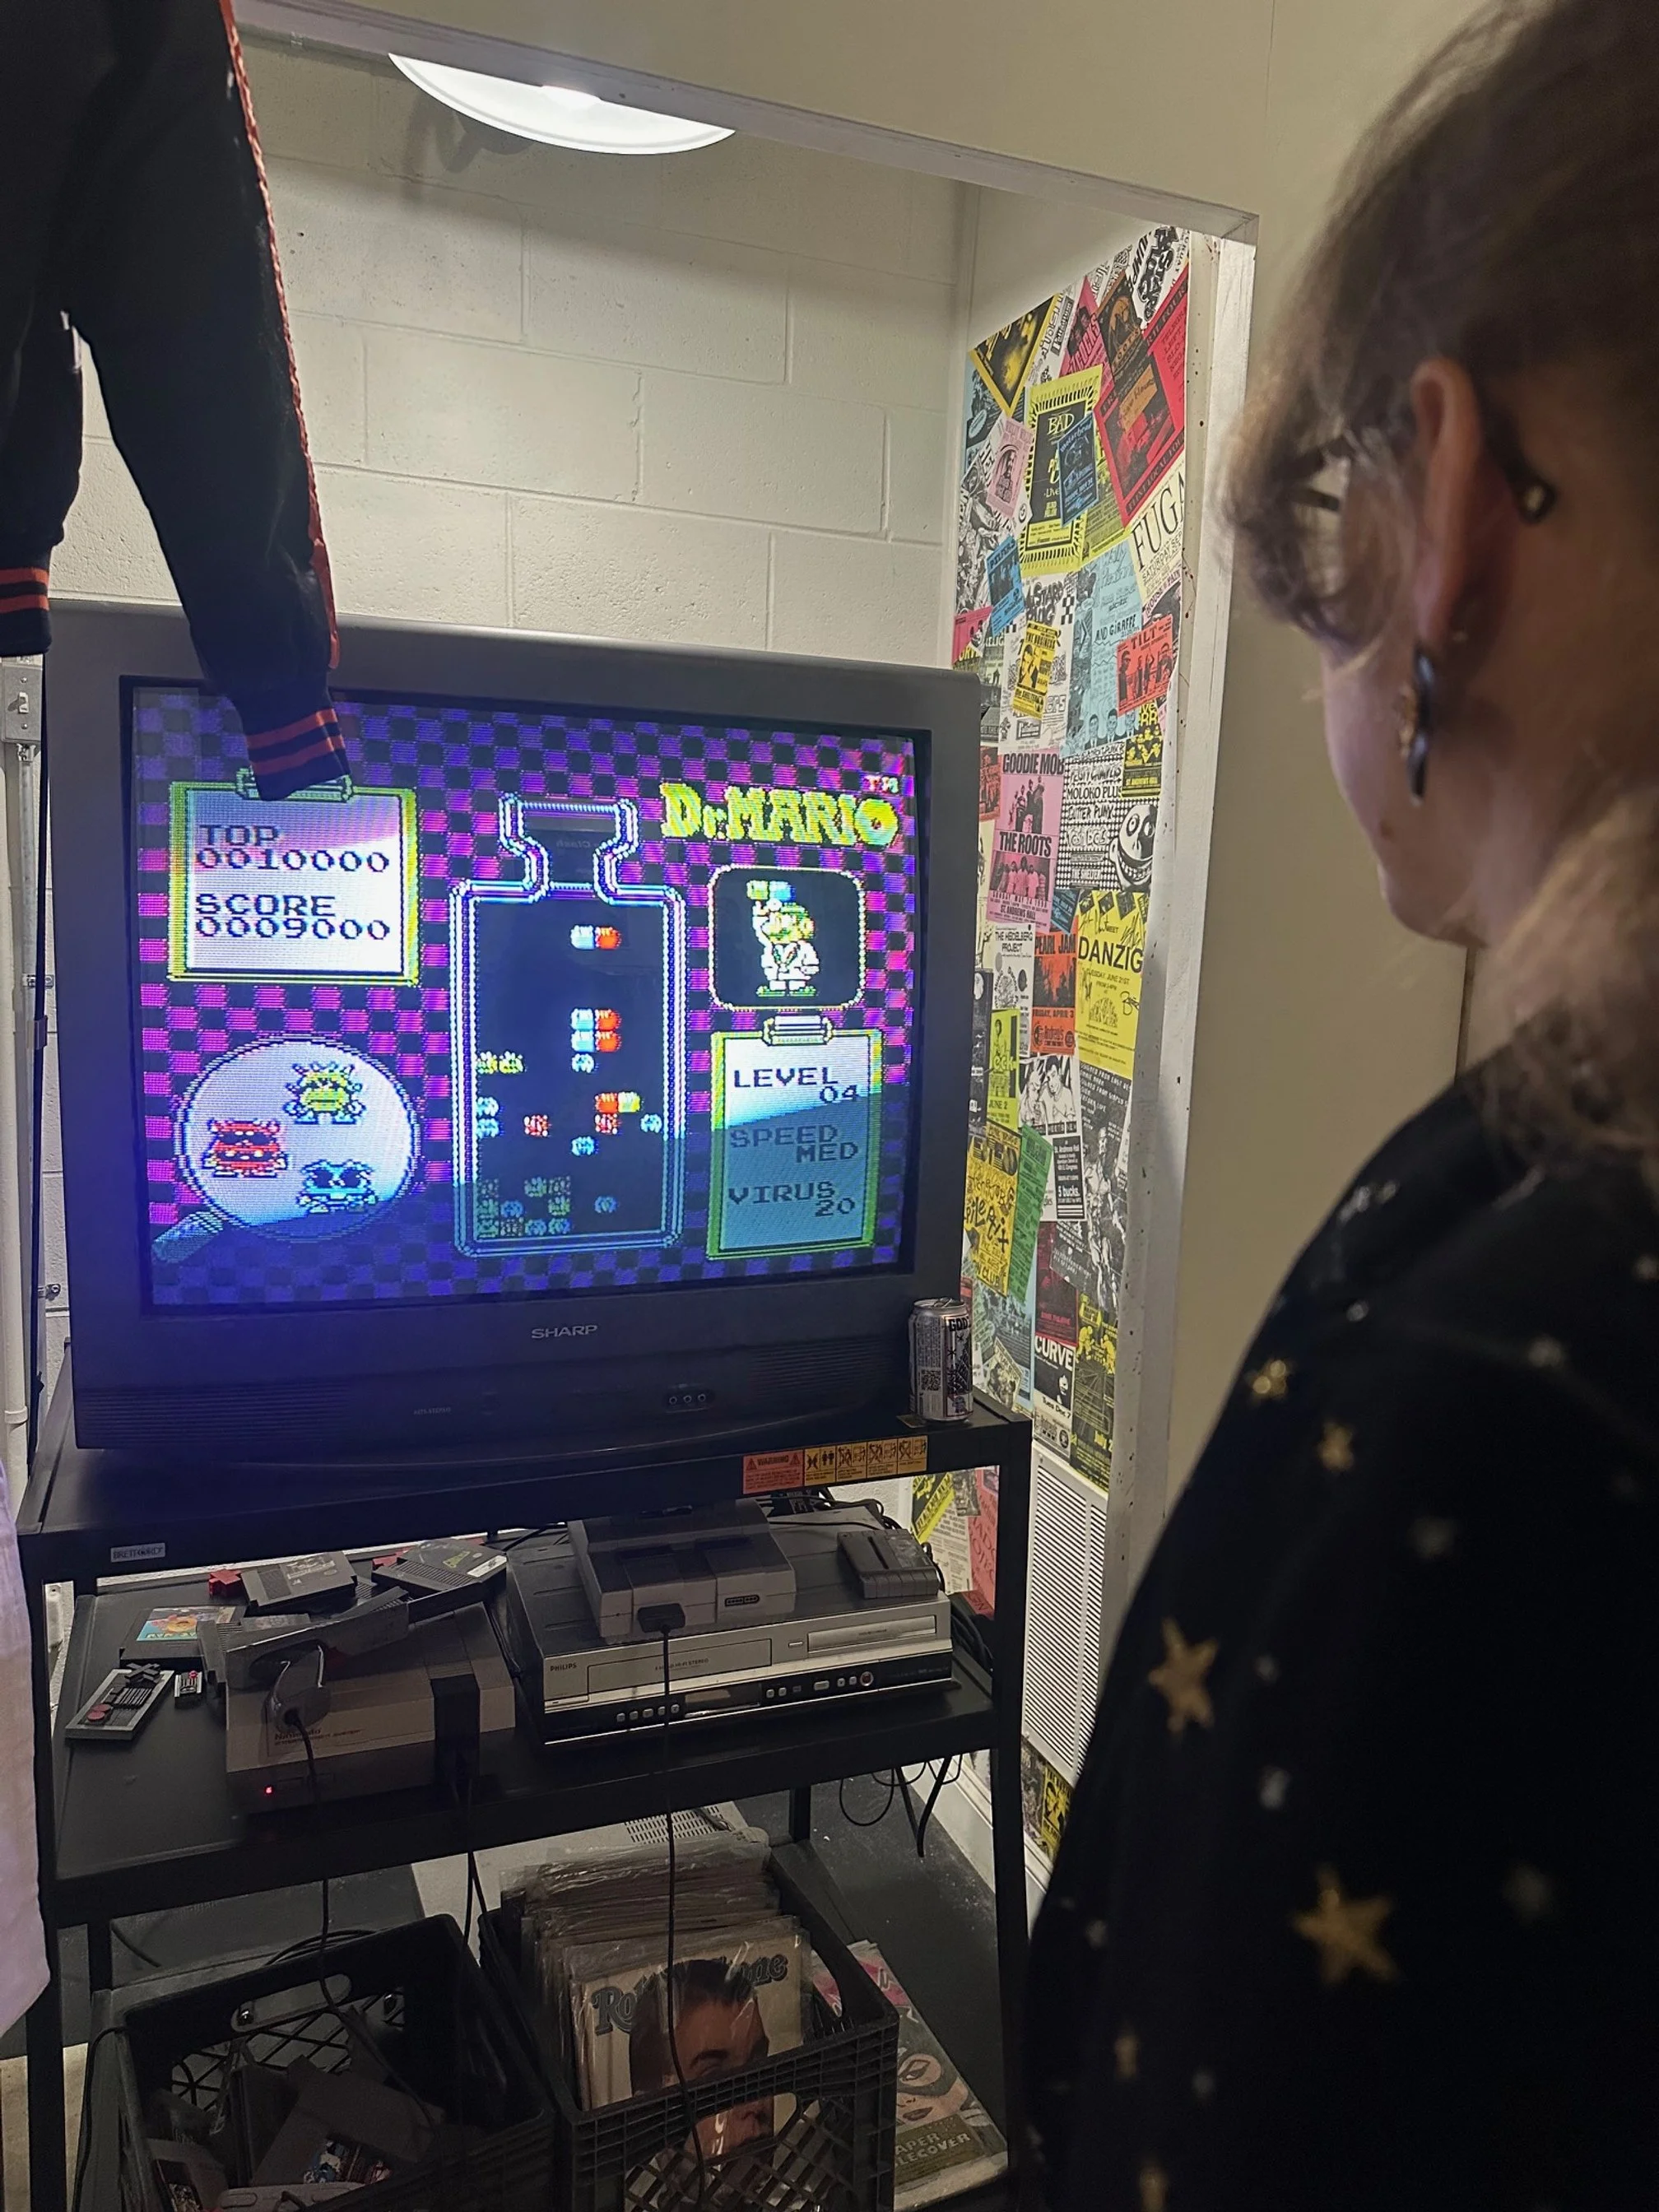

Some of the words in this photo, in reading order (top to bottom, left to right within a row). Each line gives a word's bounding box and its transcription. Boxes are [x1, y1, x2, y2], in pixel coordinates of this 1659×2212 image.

[1047, 413, 1075, 435] BAD
[1132, 625, 1157, 649] TILT
[1002, 753, 1039, 774] GOODIE
[1039, 753, 1065, 774] MOB
[1066, 786, 1100, 800] MOLOKO
[200, 824, 280, 846] TOP
[999, 832, 1019, 853] THE
[1018, 833, 1052, 857] ROOTS
[197, 848, 390, 872] 0010000
[196, 894, 337, 917] SCORE
[196, 917, 391, 940] 0009000
[995, 932, 1004, 941] THE
[1002, 943, 1023, 952] PROJECT
[1035, 936, 1055, 955] PEARL
[1059, 934, 1076, 955] JAM
[1078, 936, 1144, 974] DANZIG
[734, 1066, 839, 1088] LEVEL
[820, 1085, 859, 1104] 04
[730, 1124, 839, 1148] SPEED
[796, 1142, 859, 1163] MED
[729, 1181, 836, 1205] VIRUS
[815, 1197, 856, 1217] 20
[532, 1325, 597, 1338] SHARP
[1035, 1335, 1074, 1372] CURVE
[757, 1455, 789, 1466] WARNING
[550, 1662, 578, 1672] PHILIPS
[895, 2132, 971, 2167] LECOVER
